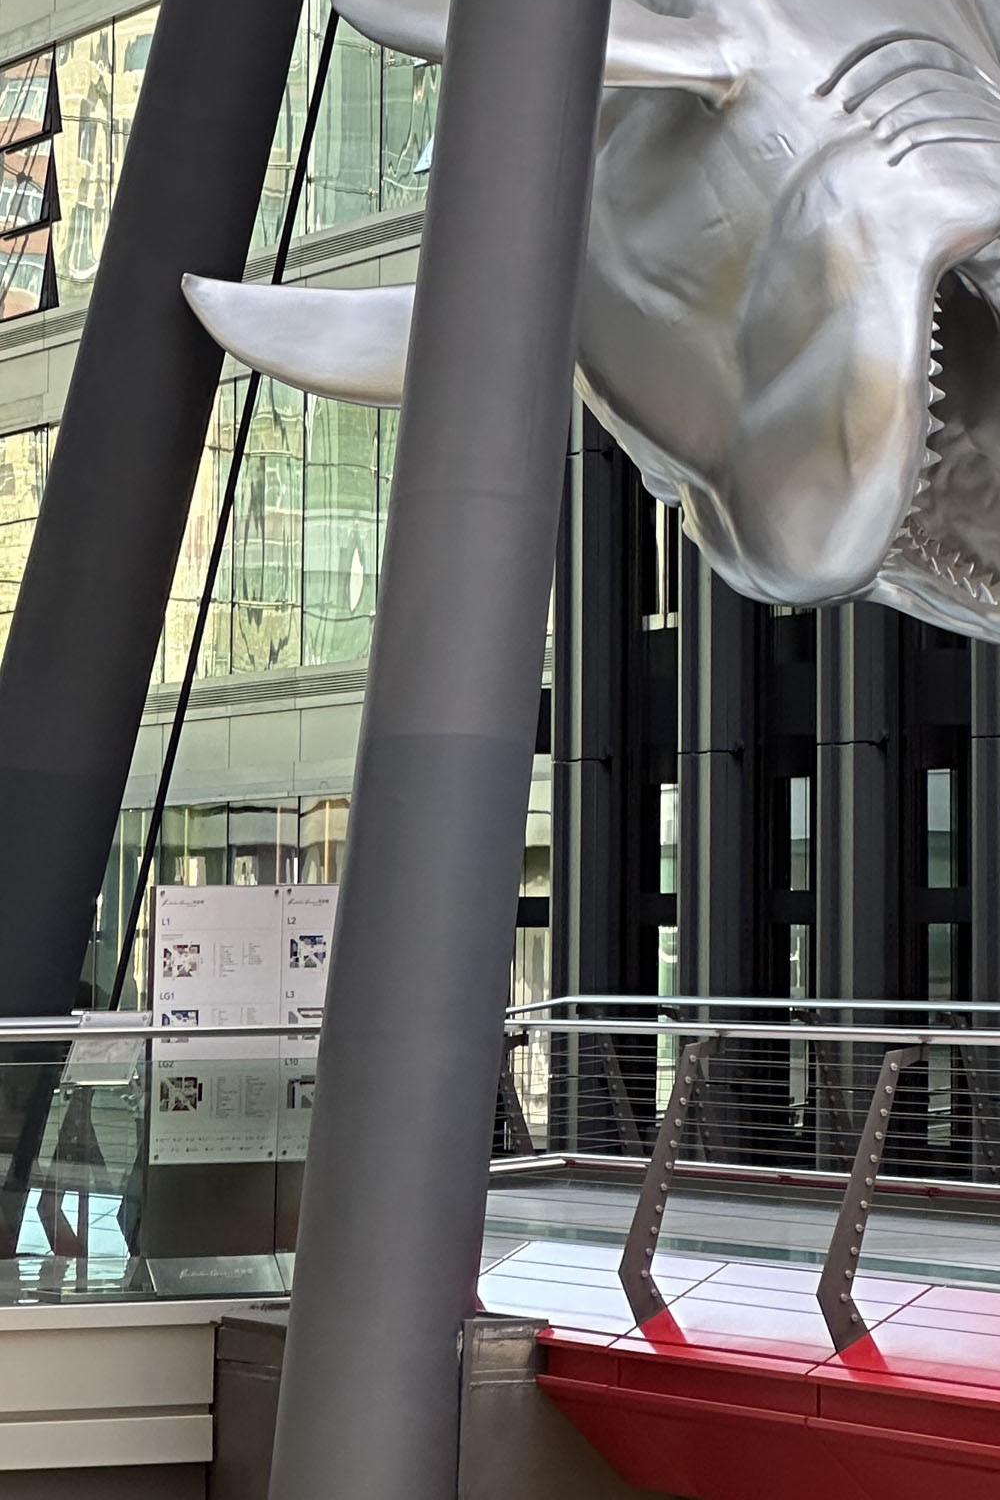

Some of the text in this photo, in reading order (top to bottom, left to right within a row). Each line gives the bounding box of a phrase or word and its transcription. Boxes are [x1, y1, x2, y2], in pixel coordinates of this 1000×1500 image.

[161, 917, 171, 926] L1
[287, 916, 297, 925] L2
[159, 992, 175, 1000] LG1
[285, 990, 295, 999] L3
